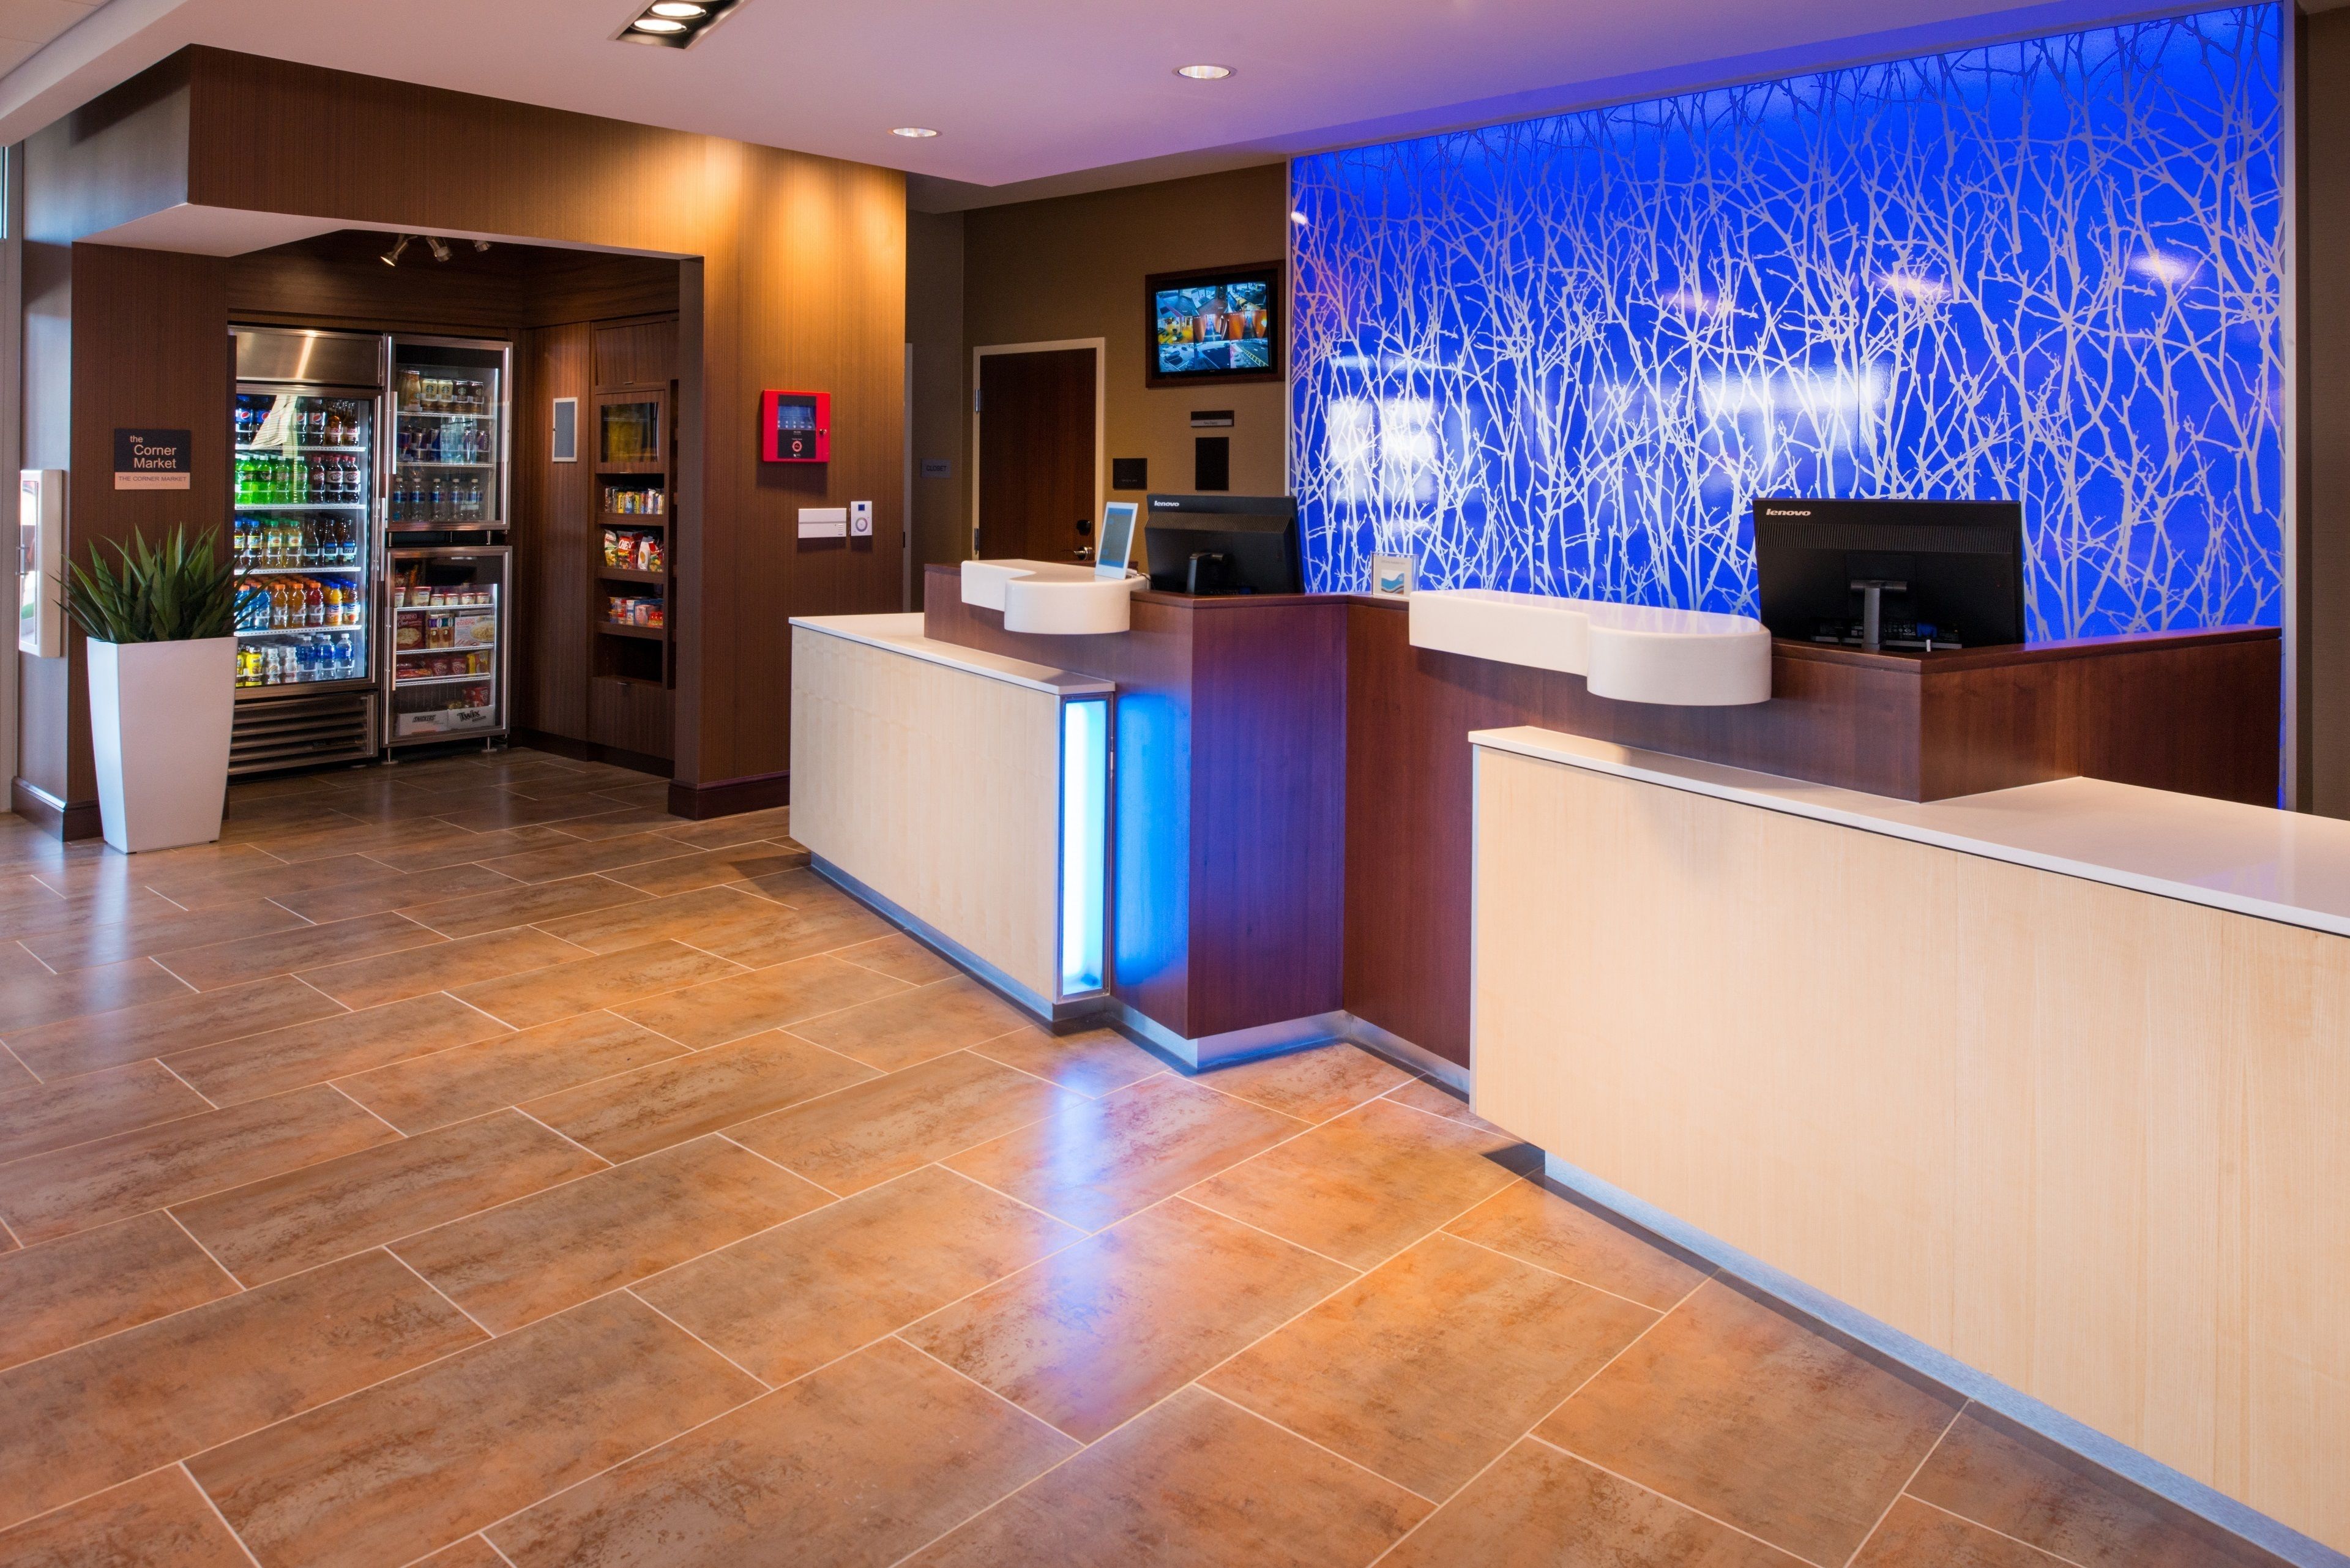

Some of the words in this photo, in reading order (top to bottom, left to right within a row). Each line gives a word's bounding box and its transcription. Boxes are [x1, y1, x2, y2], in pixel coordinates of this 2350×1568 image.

[134, 444, 177, 455] Corner
[133, 457, 177, 468] Market
[412, 714, 436, 723] SNICKERS
[457, 710, 480, 722] Twix
